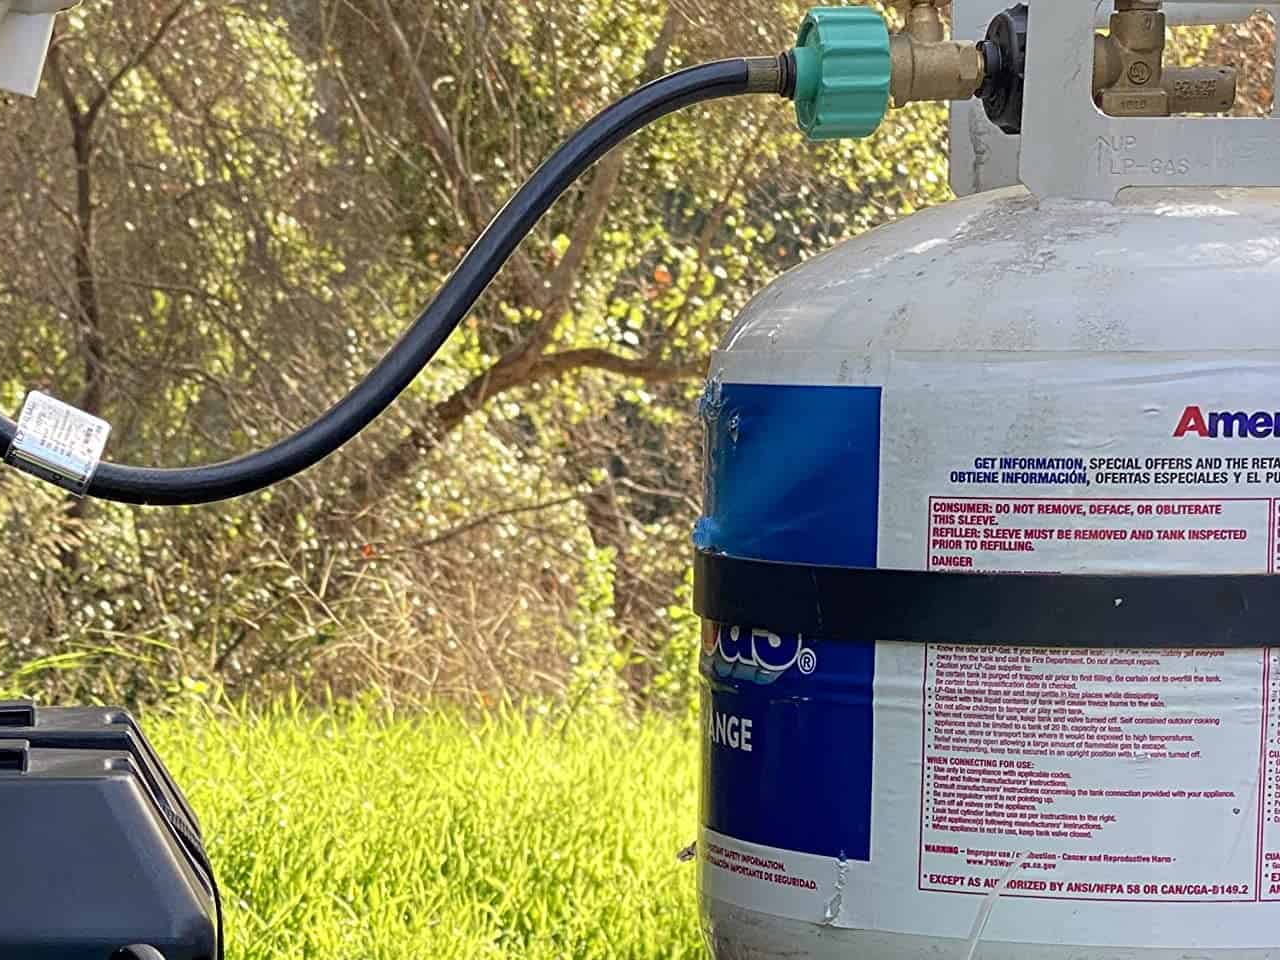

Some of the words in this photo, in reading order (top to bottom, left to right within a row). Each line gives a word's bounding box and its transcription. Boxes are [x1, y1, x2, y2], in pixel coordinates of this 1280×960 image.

[1110, 158, 1191, 176] LP-GAS
[974, 457, 997, 469] GET
[999, 457, 1086, 471] INFORMATION,
[1089, 457, 1141, 469] SPECIAL
[1145, 457, 1192, 469] OFFERS
[1195, 458, 1221, 469] AND
[1225, 457, 1248, 469] THE
[950, 471, 998, 483] OBTIENE
[1001, 470, 1089, 485] INFORMACIÓN,
[1095, 472, 1150, 483] OFERTAS
[1154, 472, 1228, 484] ESPECIALES
[1233, 471, 1241, 483] Y
[1246, 471, 1260, 483] EL
[933, 502, 992, 513] CONSUMER:
[995, 503, 1010, 513] DO
[1013, 503, 1034, 514] NOT
[1037, 504, 1086, 515] REMOVE,
[1089, 504, 1133, 515] DEFACE,
[1137, 504, 1152, 514] OR
[1156, 504, 1221, 514] OBLITERATE
[932, 514, 955, 524] THIS
[958, 514, 998, 525] SLEEVE.
[932, 527, 980, 538] REFILLER:
[983, 528, 1021, 539] SLEEVE
[1024, 529, 1054, 539] MUST
[1057, 529, 1071, 539] BE
[1074, 529, 1127, 540] REMOVED
[1130, 529, 1153, 539] AND
[1156, 530, 1184, 539] TANK
[1188, 529, 1246, 539] INSPECTED
[932, 539, 962, 549] PRIOR
[964, 540, 977, 550] TO
[980, 540, 1034, 551] REFILLING.
[931, 555, 972, 566] DANGER
[926, 756, 948, 764] WHEN
[949, 757, 997, 767] CONNECTING
[999, 760, 1014, 768] FOR
[764, 872, 773, 882] DE
[774, 875, 817, 890] SEGURIDAD.
[929, 874, 965, 885] EXCEPT
[967, 877, 980, 887] AS
[1049, 881, 1064, 891] BY
[1066, 882, 1124, 893] ANSI/NFPA
[1126, 884, 1140, 894] 58
[1143, 884, 1157, 894] OR
